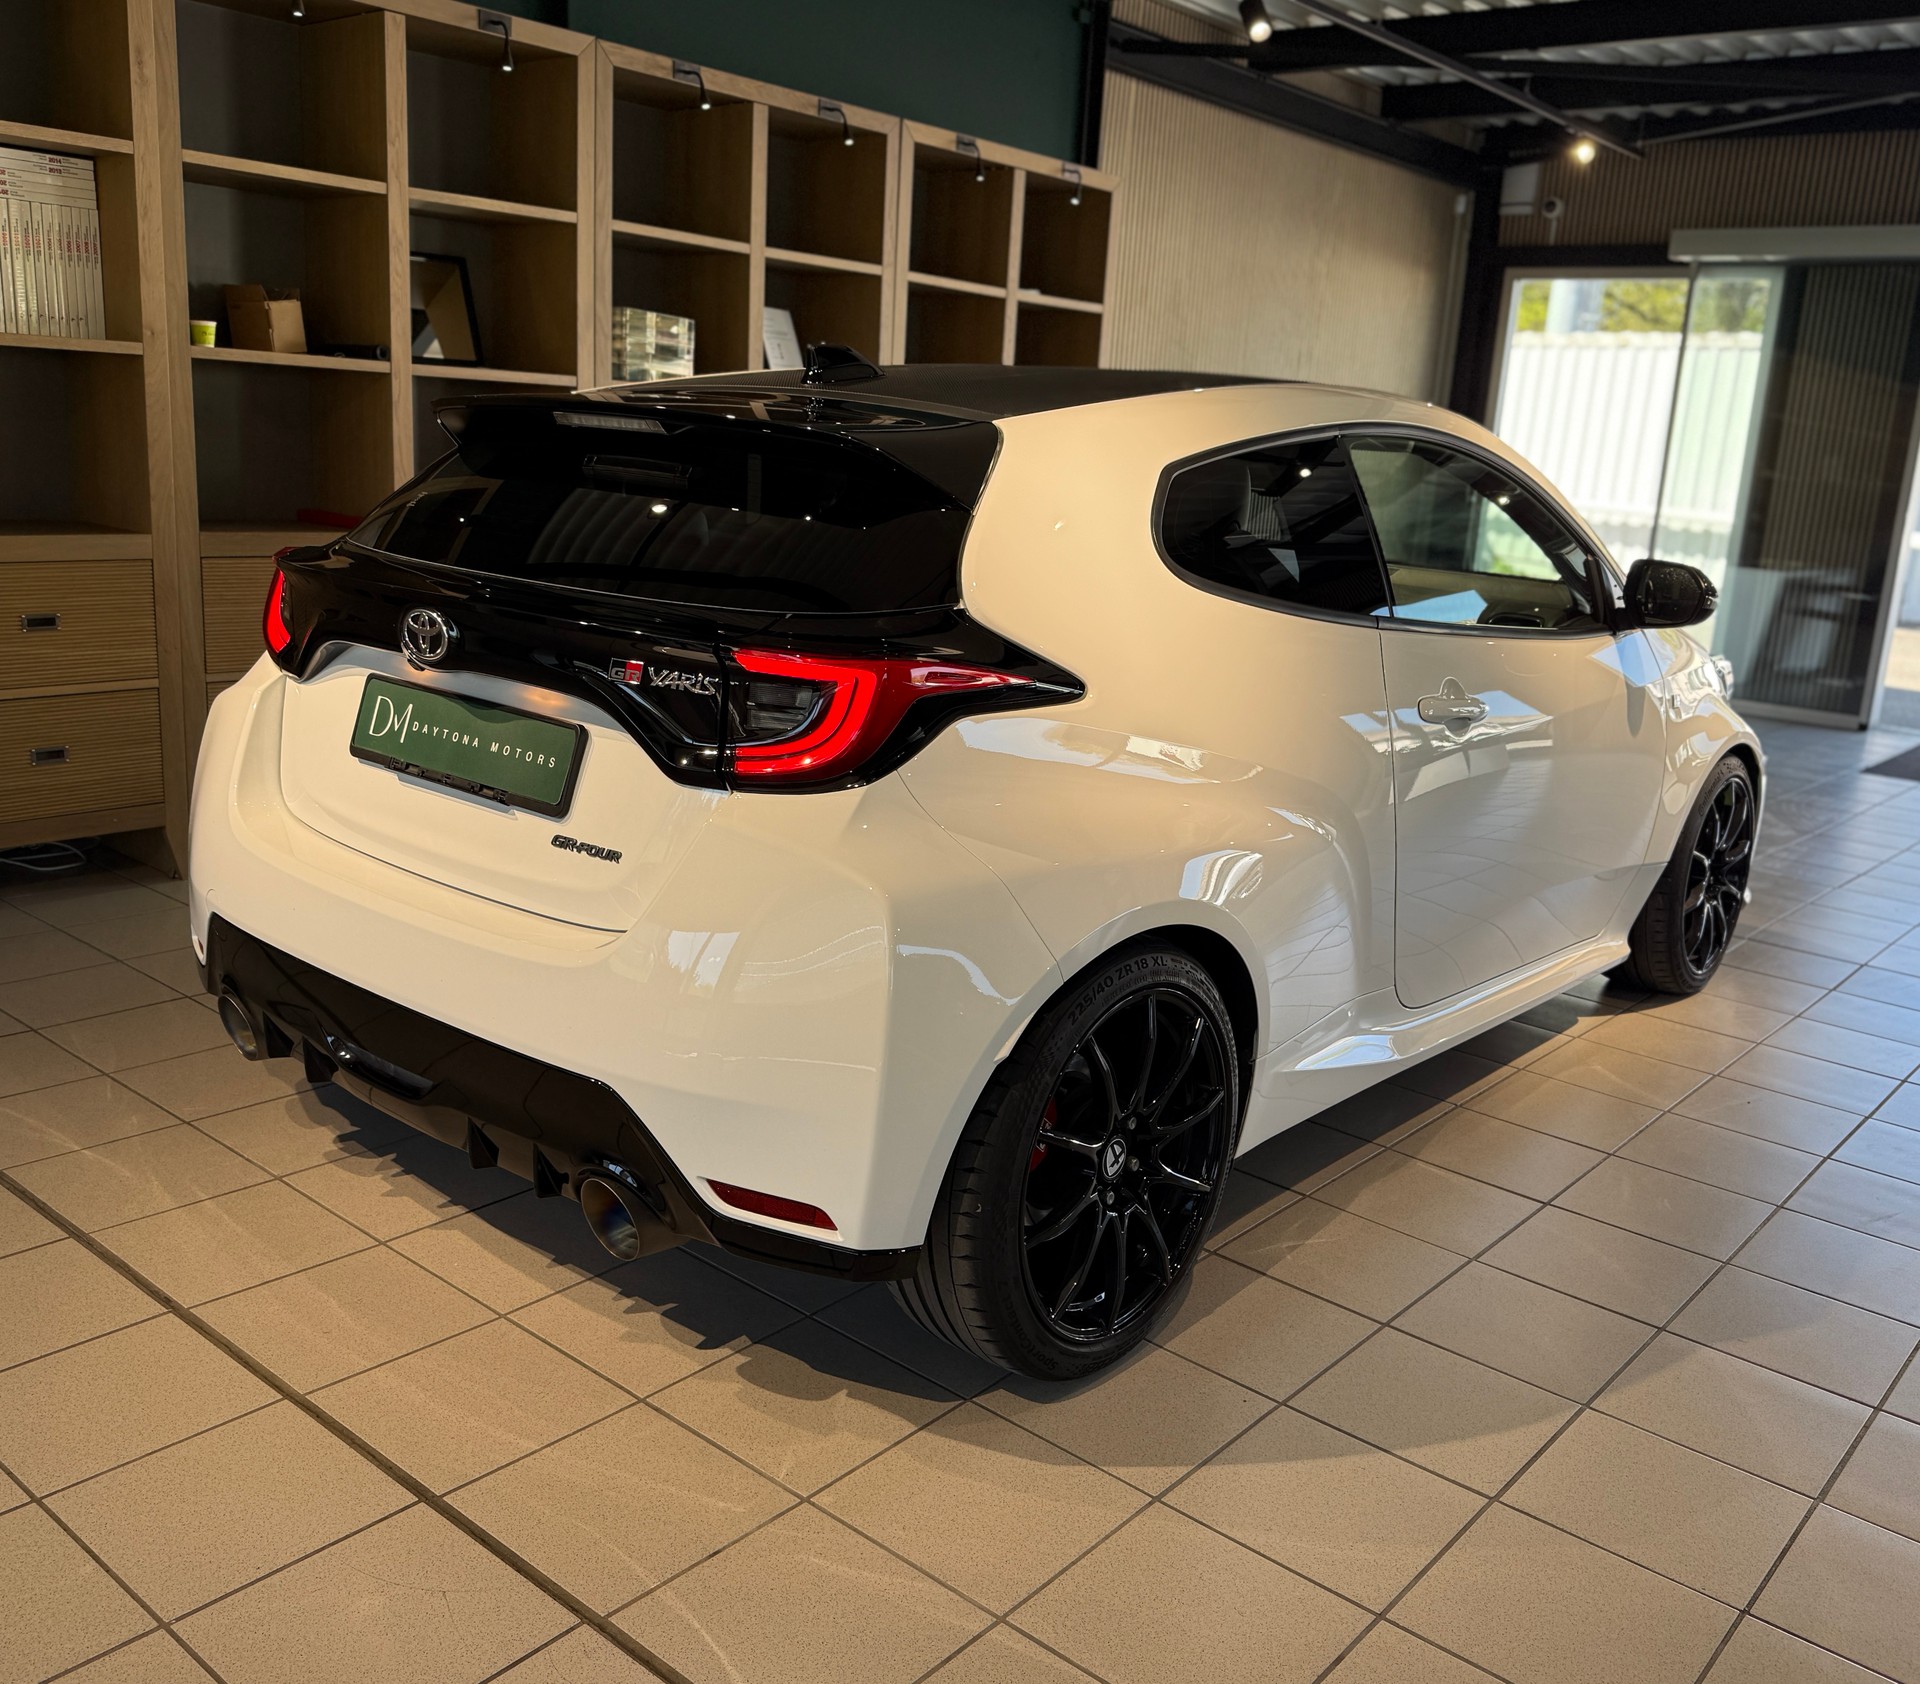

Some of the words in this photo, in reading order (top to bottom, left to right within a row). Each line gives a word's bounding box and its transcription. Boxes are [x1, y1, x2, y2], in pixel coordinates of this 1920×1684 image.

[610, 667, 640, 682] GR
[648, 666, 719, 695] YARIS
[412, 721, 479, 748] DAYTONA
[490, 742, 556, 768] MOTORS
[551, 834, 623, 864] GR-FOUR
[1067, 975, 1114, 1026] 225/40
[1151, 956, 1168, 967] XL
